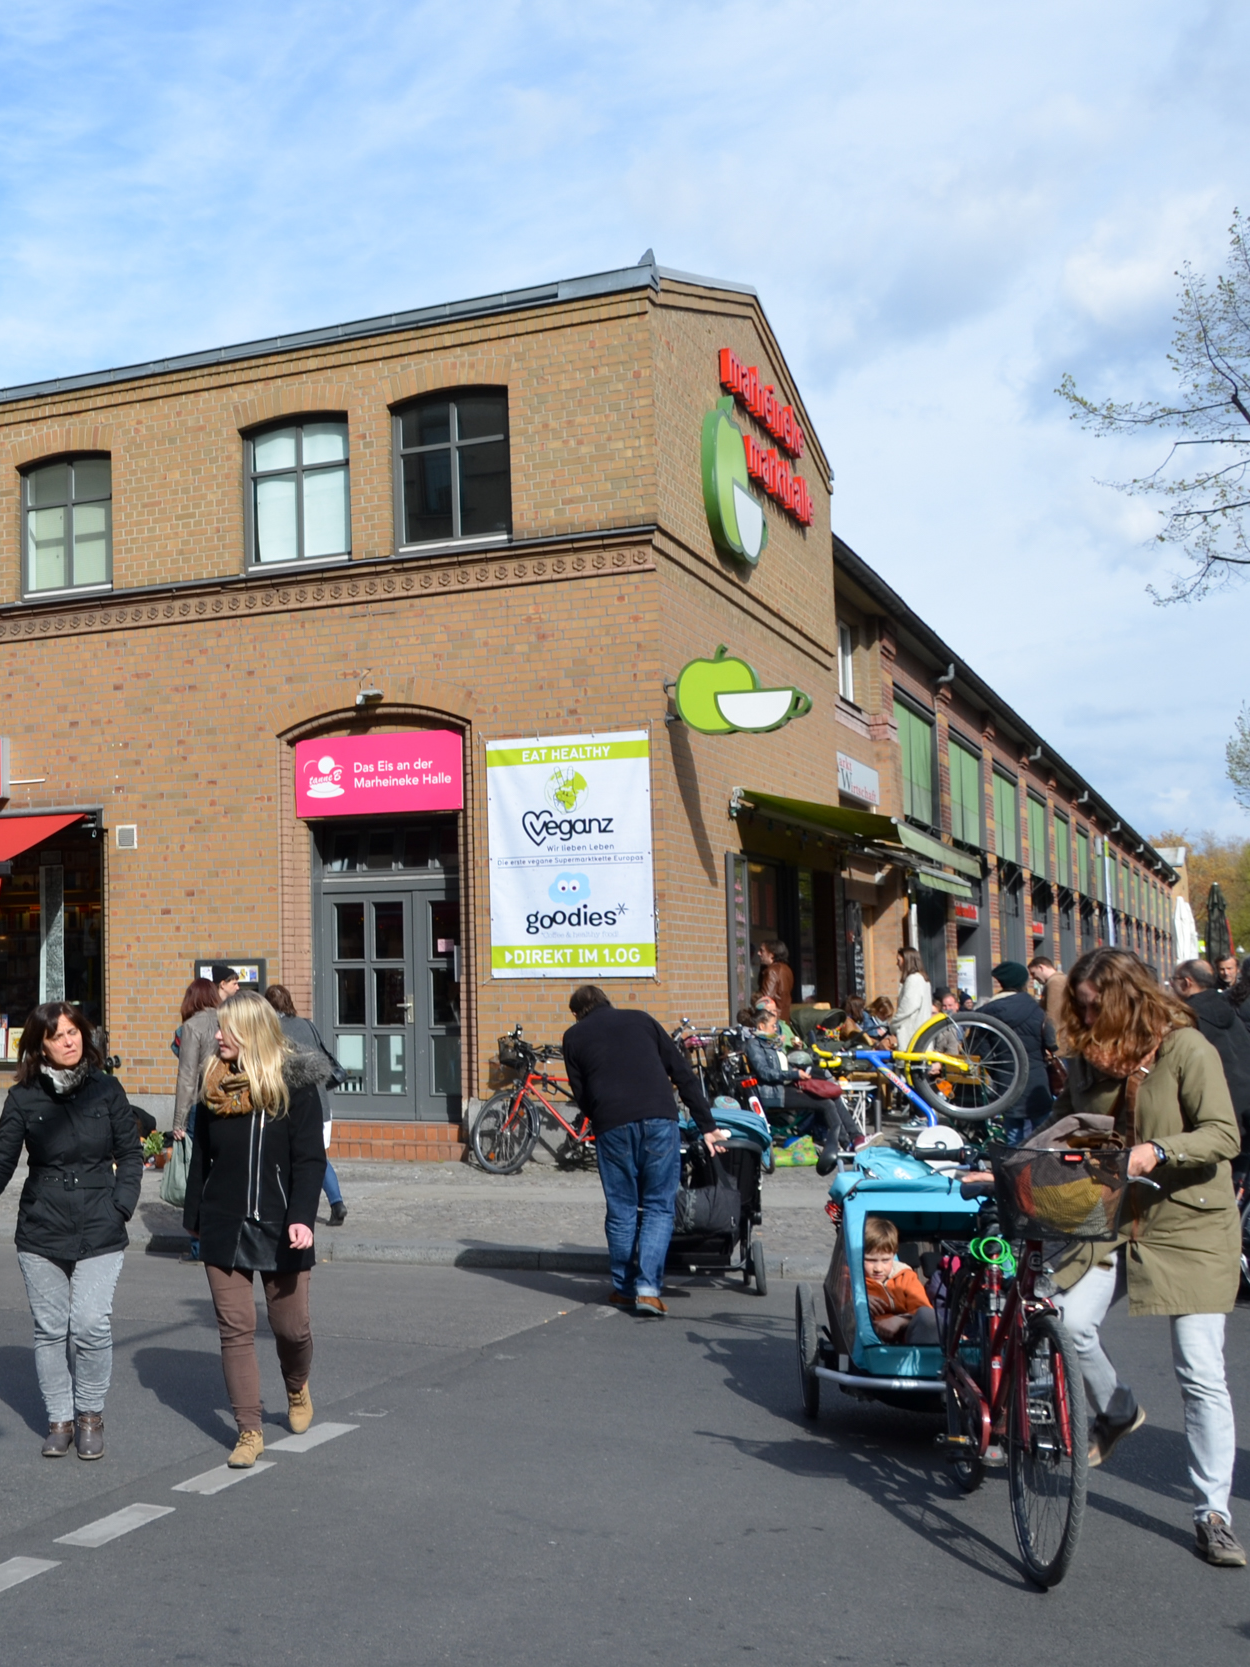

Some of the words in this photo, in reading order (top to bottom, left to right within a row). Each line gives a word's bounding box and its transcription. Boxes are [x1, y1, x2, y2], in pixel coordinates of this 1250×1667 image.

[719, 347, 805, 459] marheineke
[743, 434, 814, 527] markthalle
[522, 749, 547, 763] EAT
[551, 746, 611, 761] HEALTHY
[354, 761, 374, 773] Das
[378, 760, 393, 772] Eis
[396, 761, 410, 771] an
[413, 758, 433, 770] der
[354, 775, 419, 788] Marheineke
[422, 773, 452, 784] Halle
[522, 810, 614, 847] Veganz
[561, 844, 587, 852] lieben
[589, 843, 615, 851] Leben
[527, 858, 553, 867] vegane
[554, 855, 612, 864] Supermarktkette
[613, 854, 644, 863] Europas
[573, 930, 600, 939] healthy
[514, 949, 573, 965] DIREKT
[578, 948, 598, 963] IM
[603, 947, 641, 963] 1.OG
